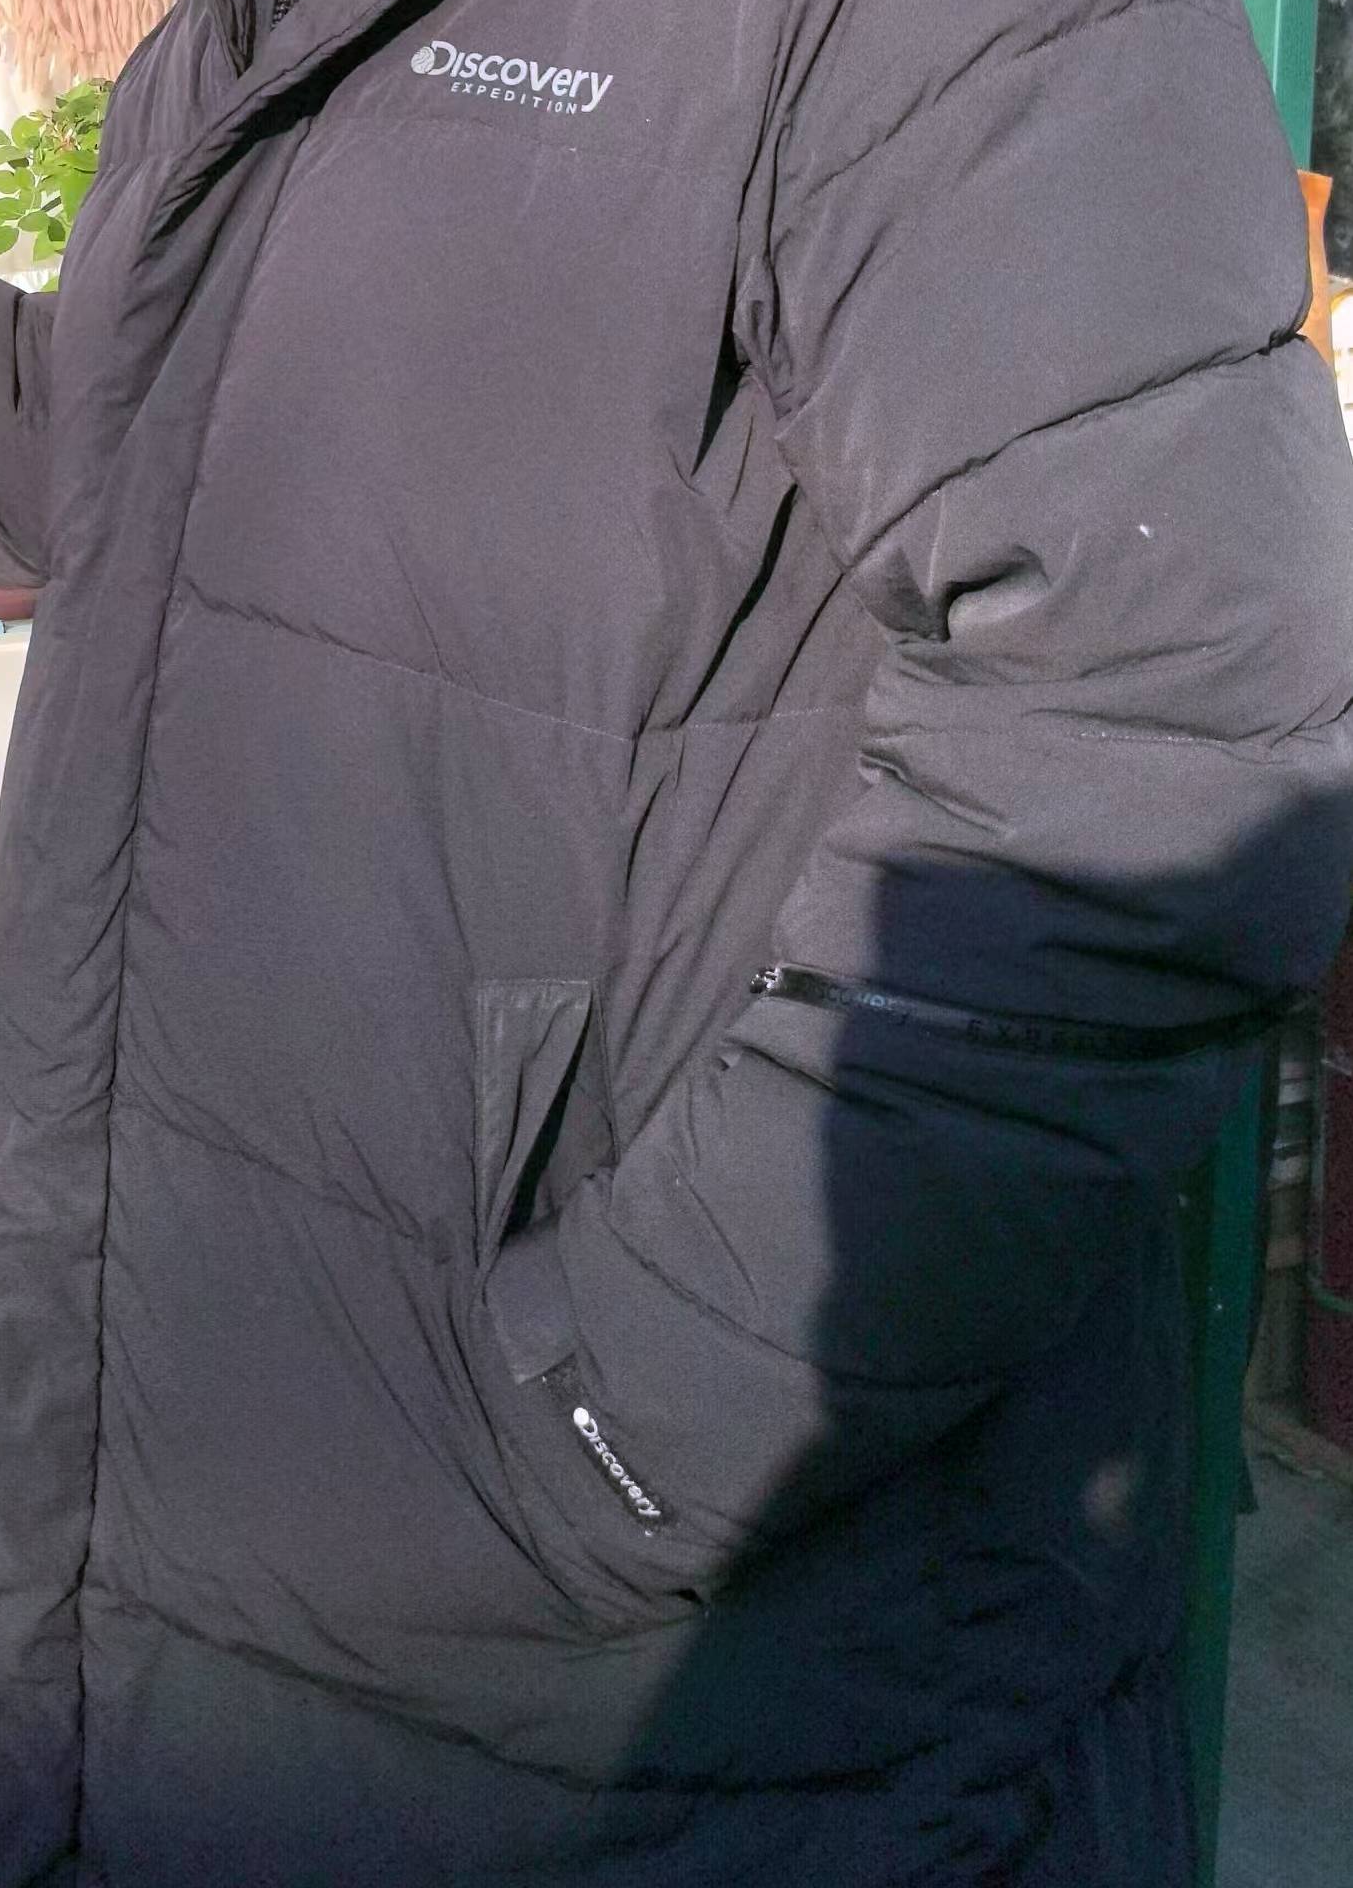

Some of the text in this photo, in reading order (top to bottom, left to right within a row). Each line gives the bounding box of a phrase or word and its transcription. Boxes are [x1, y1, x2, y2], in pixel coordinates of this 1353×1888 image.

[426, 40, 614, 113] Discovery
[450, 81, 578, 115] EXPEDITION
[577, 1414, 662, 1517] Discovery
